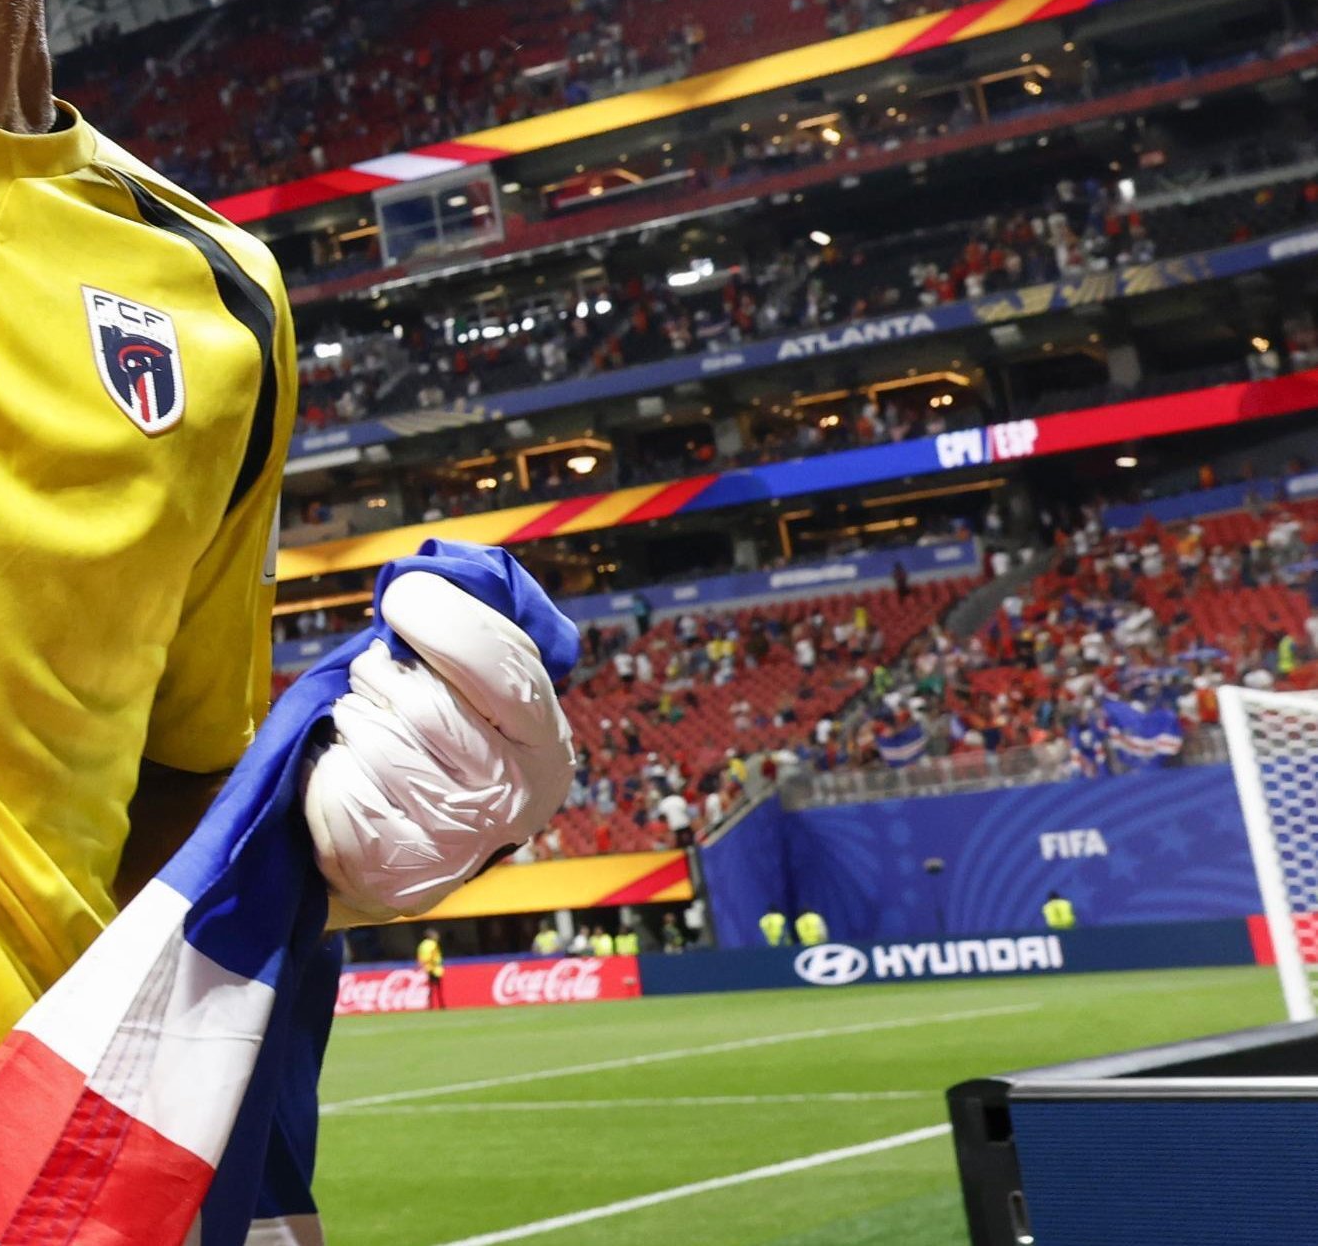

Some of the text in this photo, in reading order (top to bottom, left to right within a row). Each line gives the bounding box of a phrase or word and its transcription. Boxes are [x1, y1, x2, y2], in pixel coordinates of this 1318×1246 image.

[93, 294, 165, 328] FCF
[776, 323, 936, 361] ATLANTA
[935, 418, 1038, 469] CPV ESP
[1039, 828, 1108, 861] FIFA
[872, 935, 1064, 978] HYUNDAI
